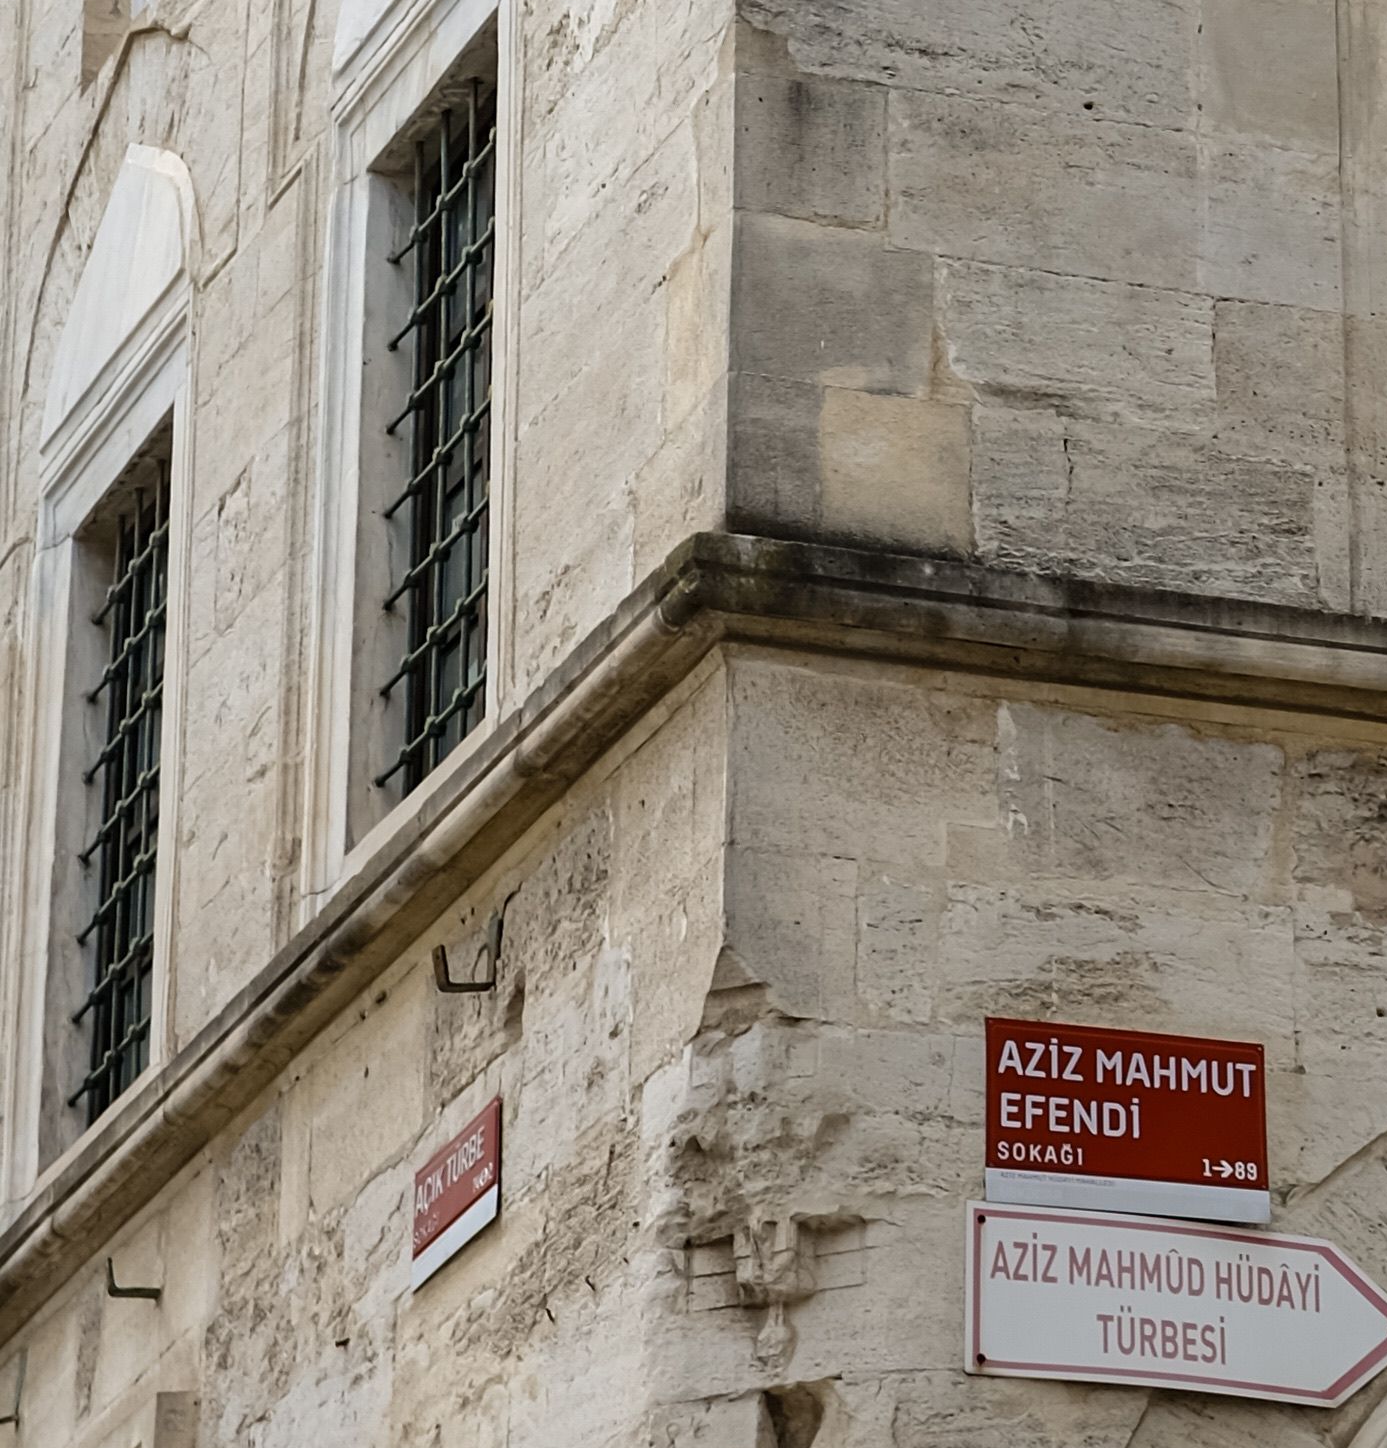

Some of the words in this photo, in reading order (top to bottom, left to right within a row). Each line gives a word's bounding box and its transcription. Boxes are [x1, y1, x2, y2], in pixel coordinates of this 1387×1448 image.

[998, 1038, 1083, 1082] AZİZ
[1096, 1048, 1257, 1098] MAHMUT
[1000, 1092, 1141, 1139] EFENDİ
[997, 1141, 1084, 1166] SOKAĞI
[990, 1232, 1058, 1283] AZİZ
[1069, 1246, 1205, 1297] MAHMÛD
[1215, 1254, 1321, 1312] HÜDÂYİ
[1097, 1306, 1226, 1365] TÜRBESİ
